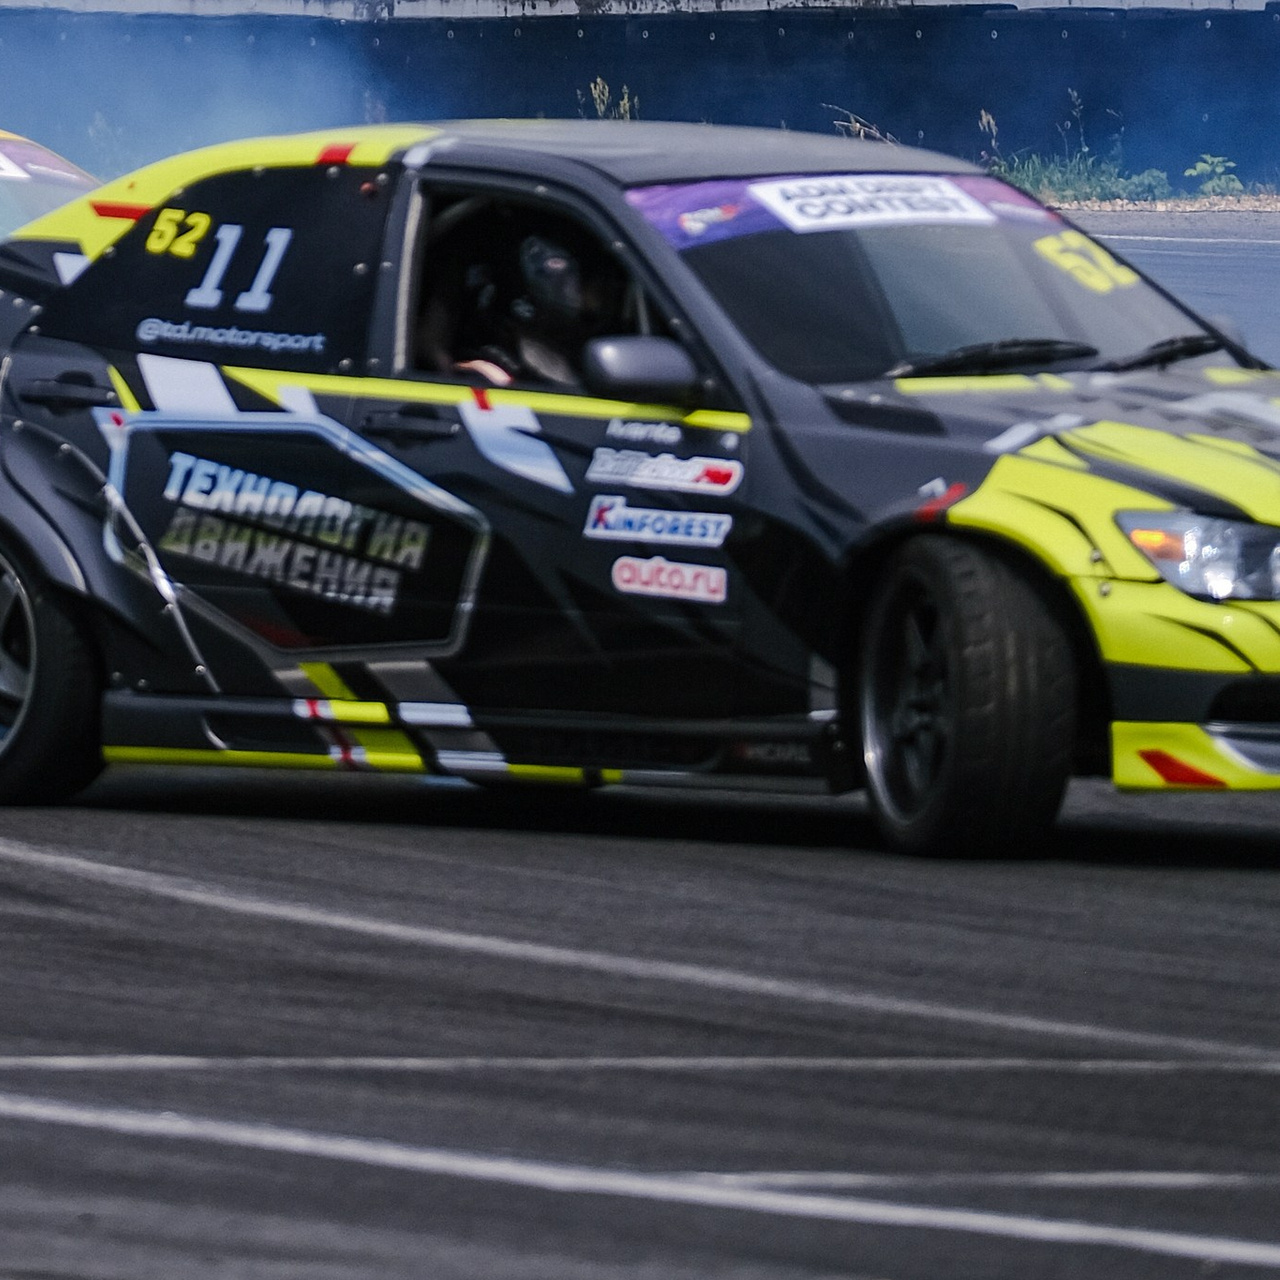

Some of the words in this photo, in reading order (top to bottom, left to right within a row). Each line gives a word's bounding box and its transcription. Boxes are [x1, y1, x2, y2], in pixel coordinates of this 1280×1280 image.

[145, 207, 212, 259] 52
[795, 196, 968, 219] CONTEST
[184, 223, 294, 312] 11
